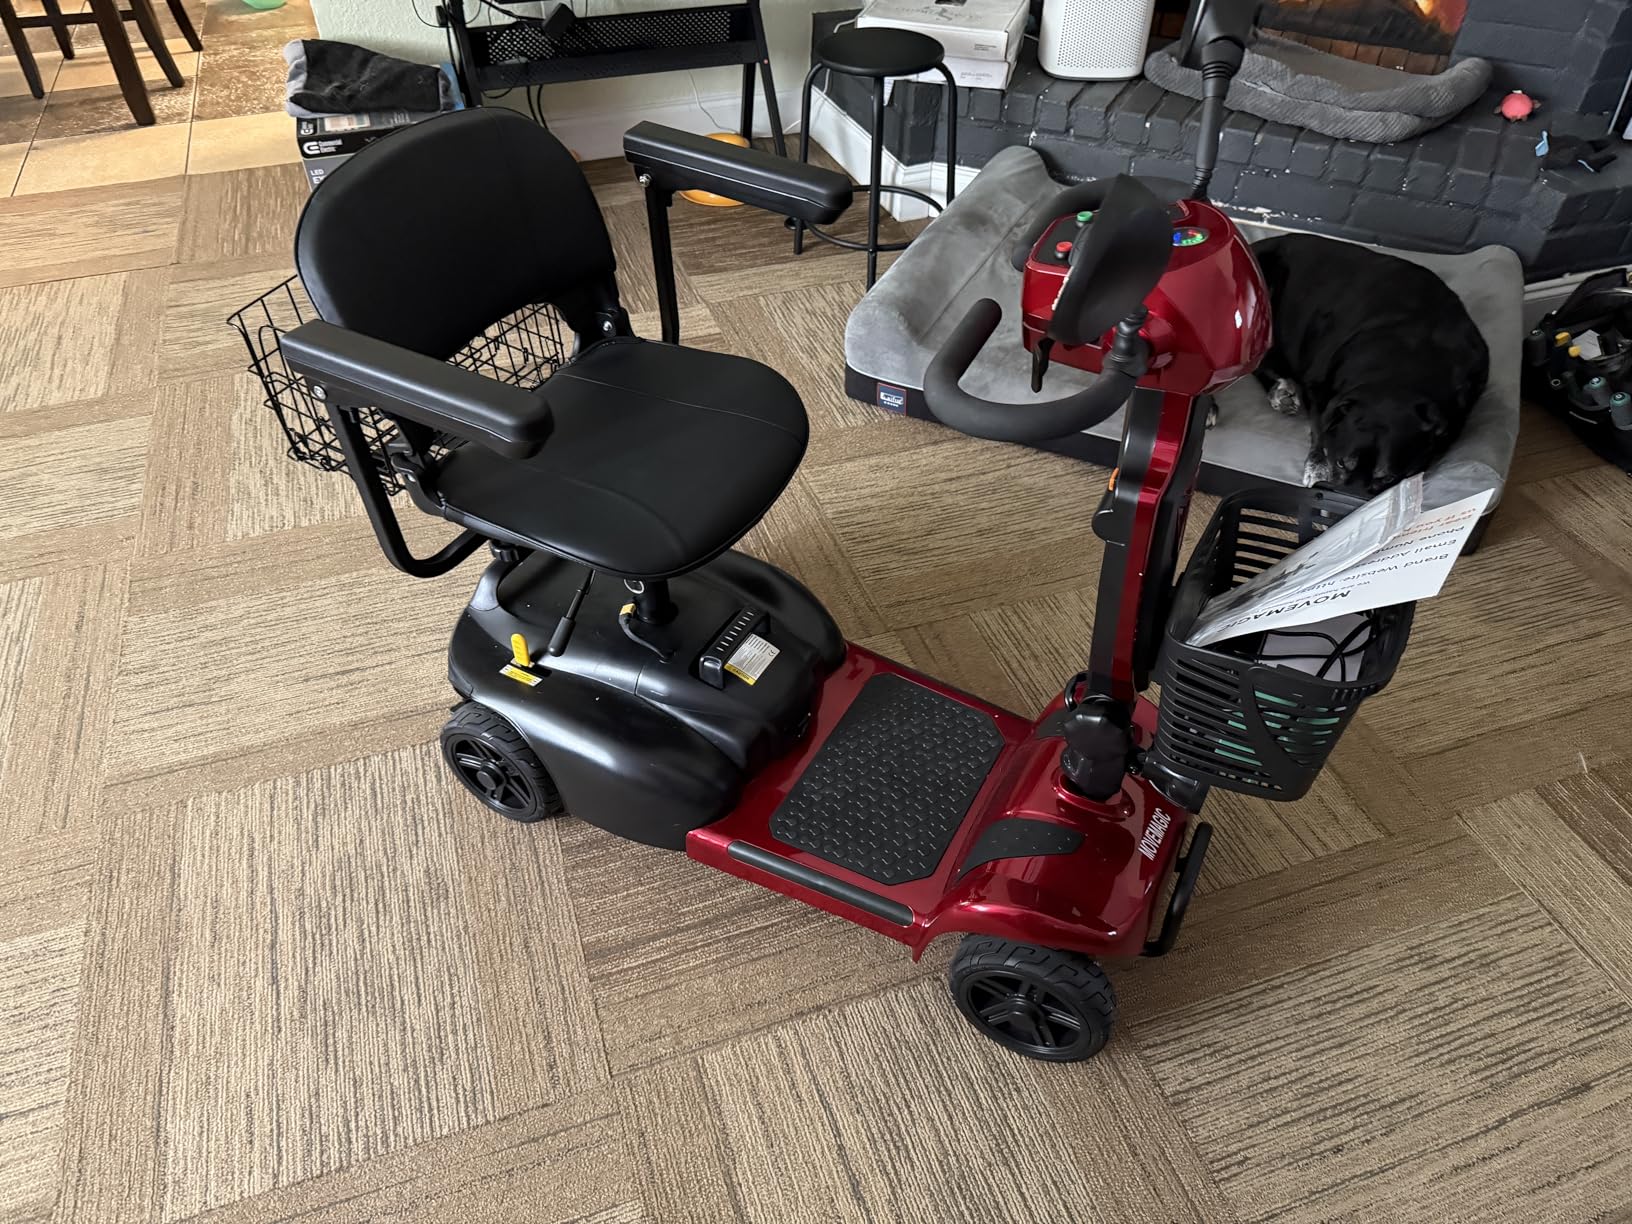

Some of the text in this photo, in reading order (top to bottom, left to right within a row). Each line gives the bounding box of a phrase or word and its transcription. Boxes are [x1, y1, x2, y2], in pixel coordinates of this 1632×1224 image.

[310, 168, 325, 176] LED
[1418, 526, 1465, 541] Phone
[1414, 539, 1457, 554] Email
[1403, 553, 1449, 568] Brand
[1137, 807, 1172, 861] MOVEMAGIC
